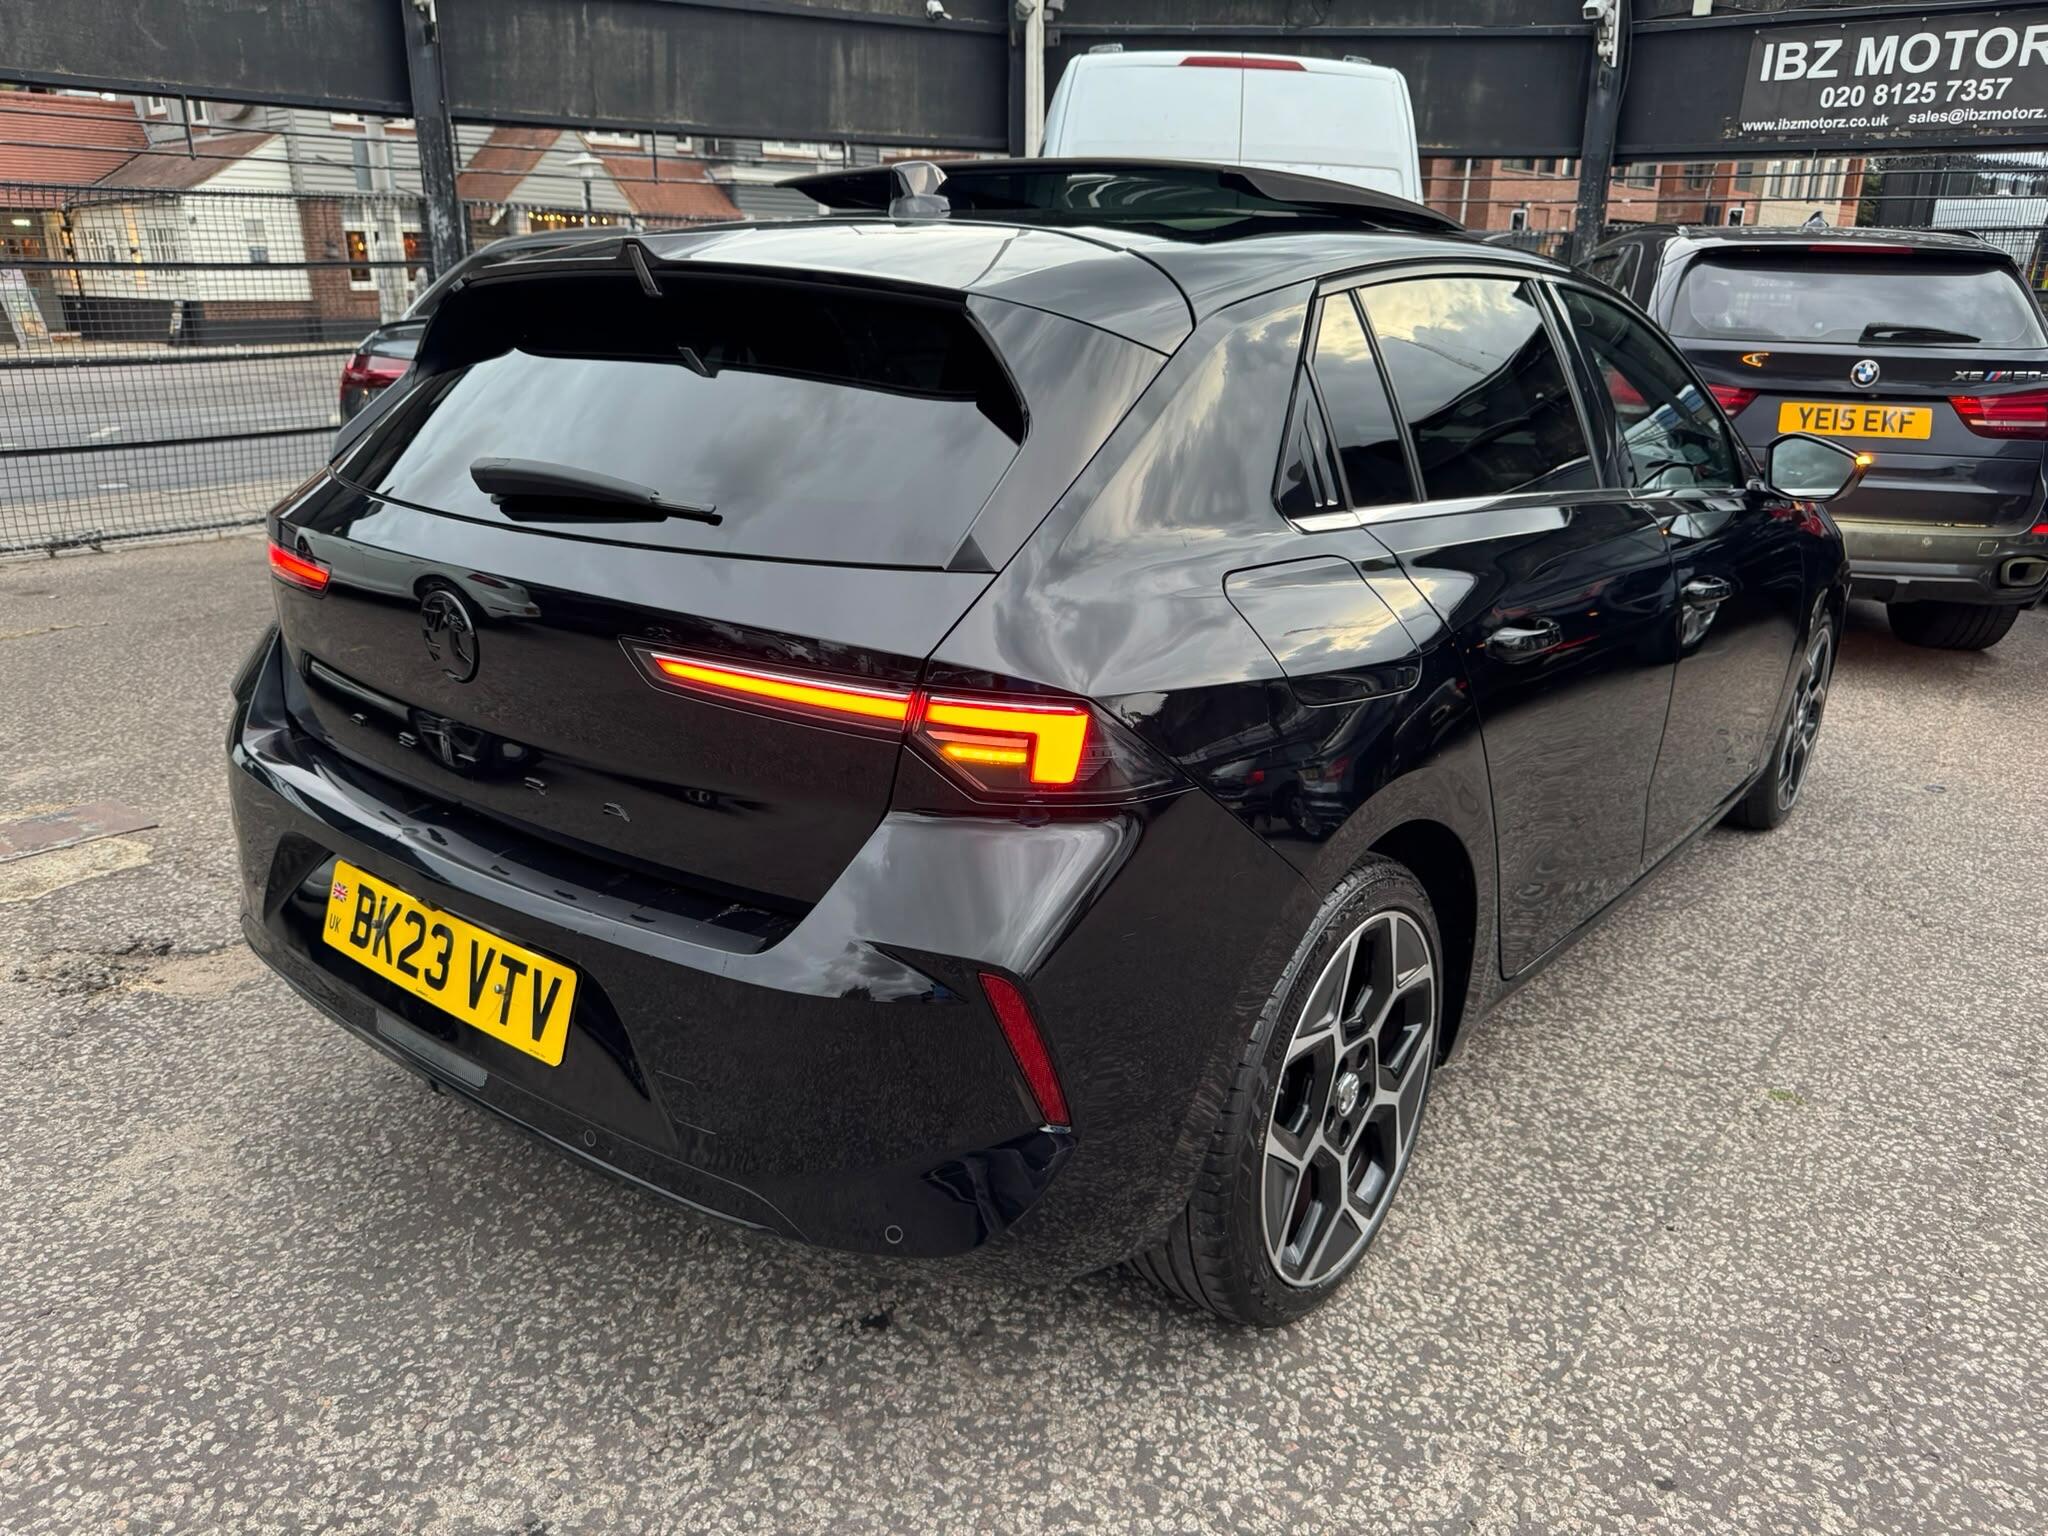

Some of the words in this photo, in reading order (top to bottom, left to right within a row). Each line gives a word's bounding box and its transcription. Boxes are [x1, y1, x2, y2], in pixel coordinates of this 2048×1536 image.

[1759, 39, 1844, 82] IBZ
[1819, 86, 1866, 109] 020
[1872, 81, 1938, 106] 8125
[1946, 77, 2013, 103] 7357
[1741, 114, 1889, 132] www.ibzmotorz.co.uk
[1799, 406, 1856, 432] YE15
[1862, 409, 1916, 434] EKF
[329, 912, 342, 934] UK
[349, 883, 454, 992] BK23
[468, 938, 563, 1043] VTV
